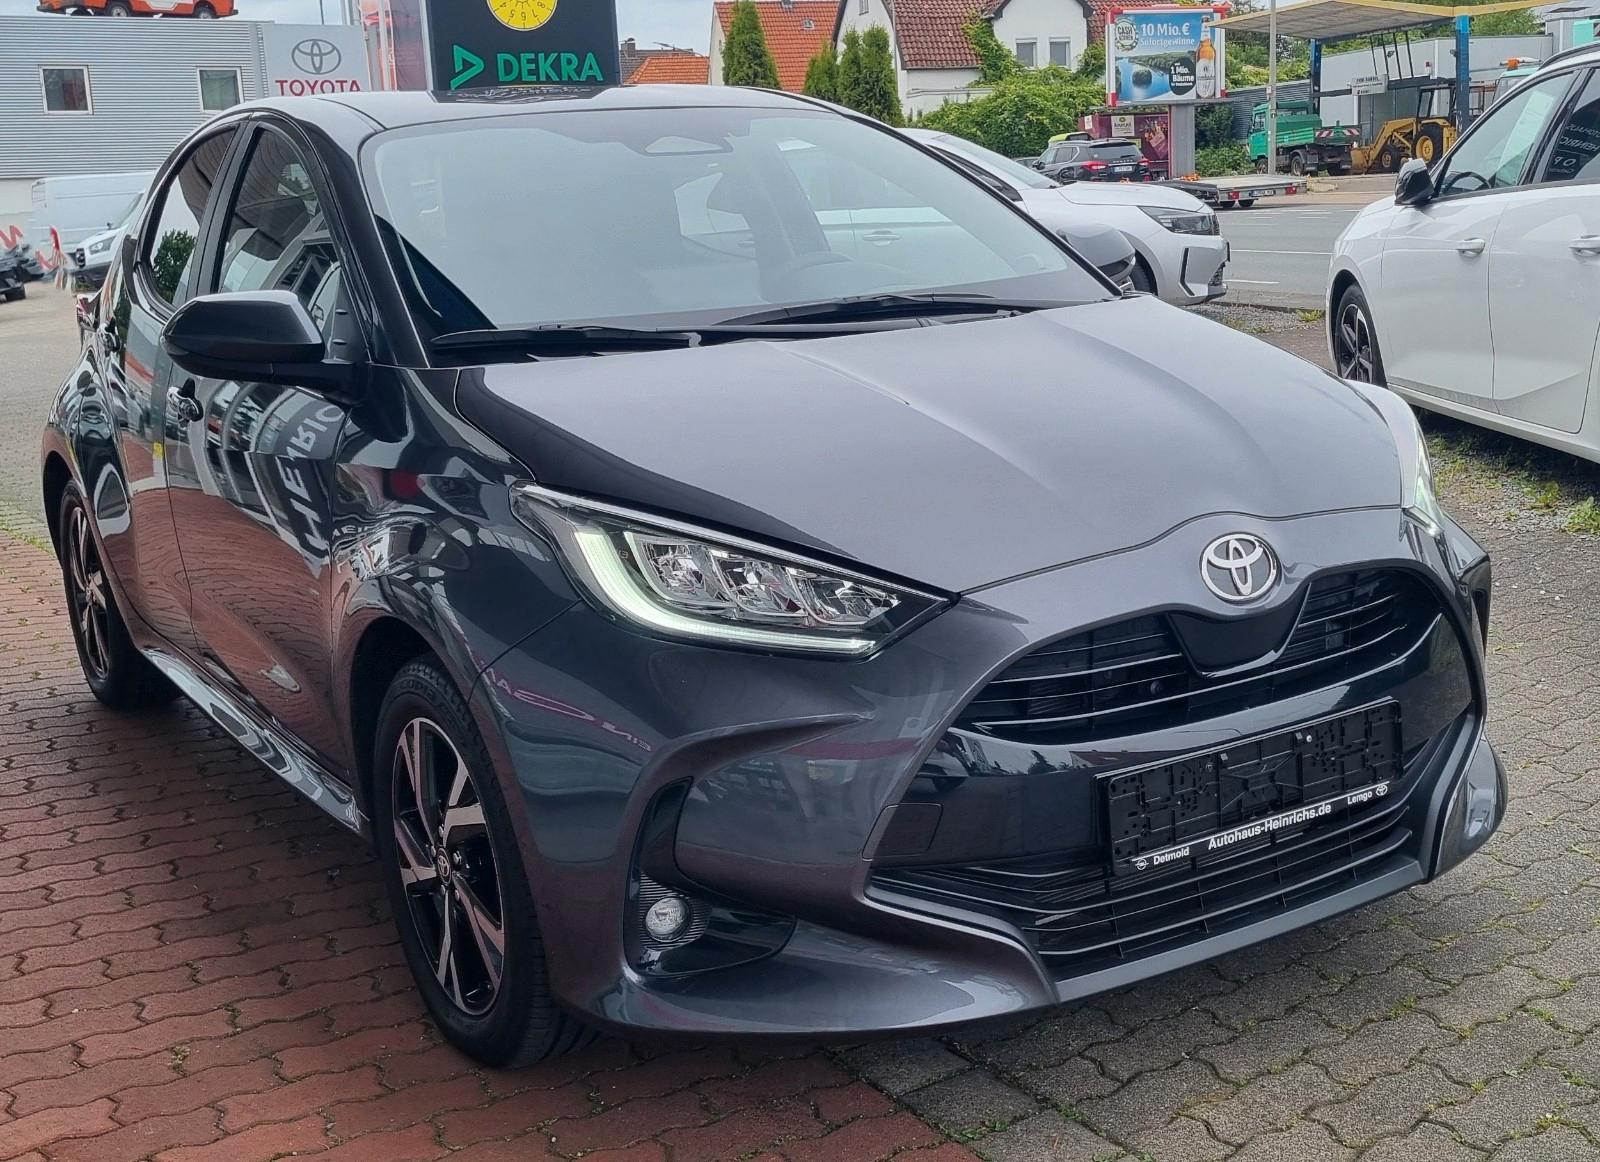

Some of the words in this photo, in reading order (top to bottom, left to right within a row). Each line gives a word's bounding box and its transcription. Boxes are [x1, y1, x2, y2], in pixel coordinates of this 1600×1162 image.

[1140, 24, 1154, 36] 10
[1158, 24, 1181, 36] Mio.
[1182, 22, 1190, 36] €
[1140, 38, 1195, 48] Sofortgewinne
[496, 50, 604, 83] DEKRA
[1170, 66, 1175, 74] 1
[1176, 66, 1190, 74] Mio.
[1172, 74, 1194, 82] Bäume
[274, 79, 361, 96] TOYOTA
[1152, 846, 1190, 866] Detmold
[1208, 802, 1332, 850] Autohaus-Heinrichs.de
[1346, 789, 1372, 805] Lemgo
